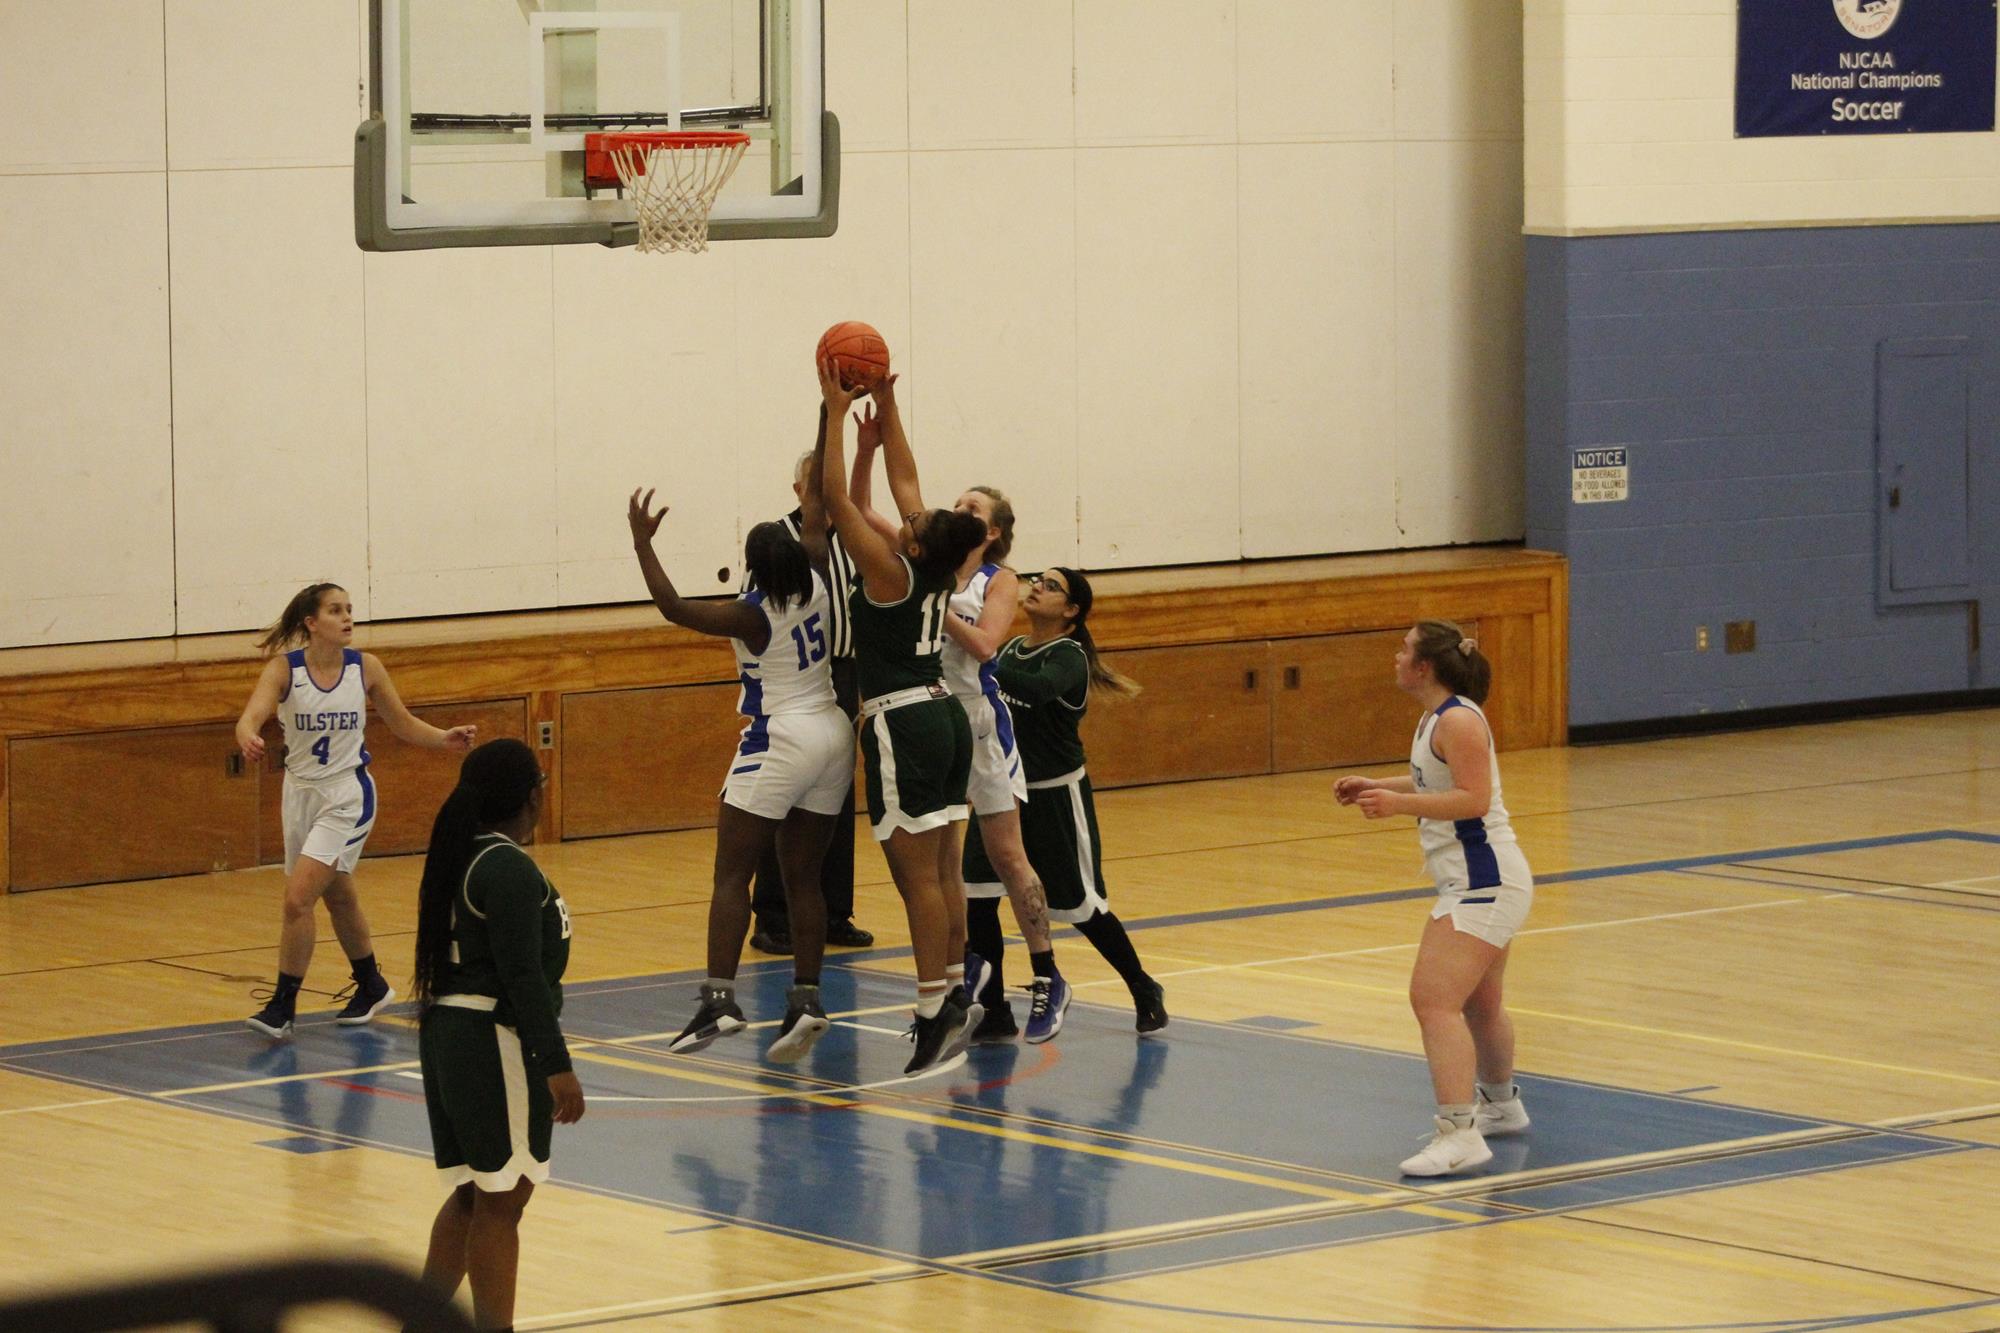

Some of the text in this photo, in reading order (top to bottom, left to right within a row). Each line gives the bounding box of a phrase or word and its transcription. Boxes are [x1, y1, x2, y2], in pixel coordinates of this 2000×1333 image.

[1839, 52, 1893, 69] NJCAA
[1791, 71, 1942, 91] National Champions
[1831, 97, 1903, 121] Soccer
[1577, 451, 1623, 467] NOTICE
[1578, 470, 1587, 479] NO
[1584, 480, 1599, 490] FOOD
[1602, 479, 1625, 489] ALLOWED
[1604, 490, 1618, 499] AREA
[915, 589, 951, 656] 11
[791, 611, 826, 672] 15
[295, 711, 358, 732] ULSTER
[311, 736, 331, 766] 4
